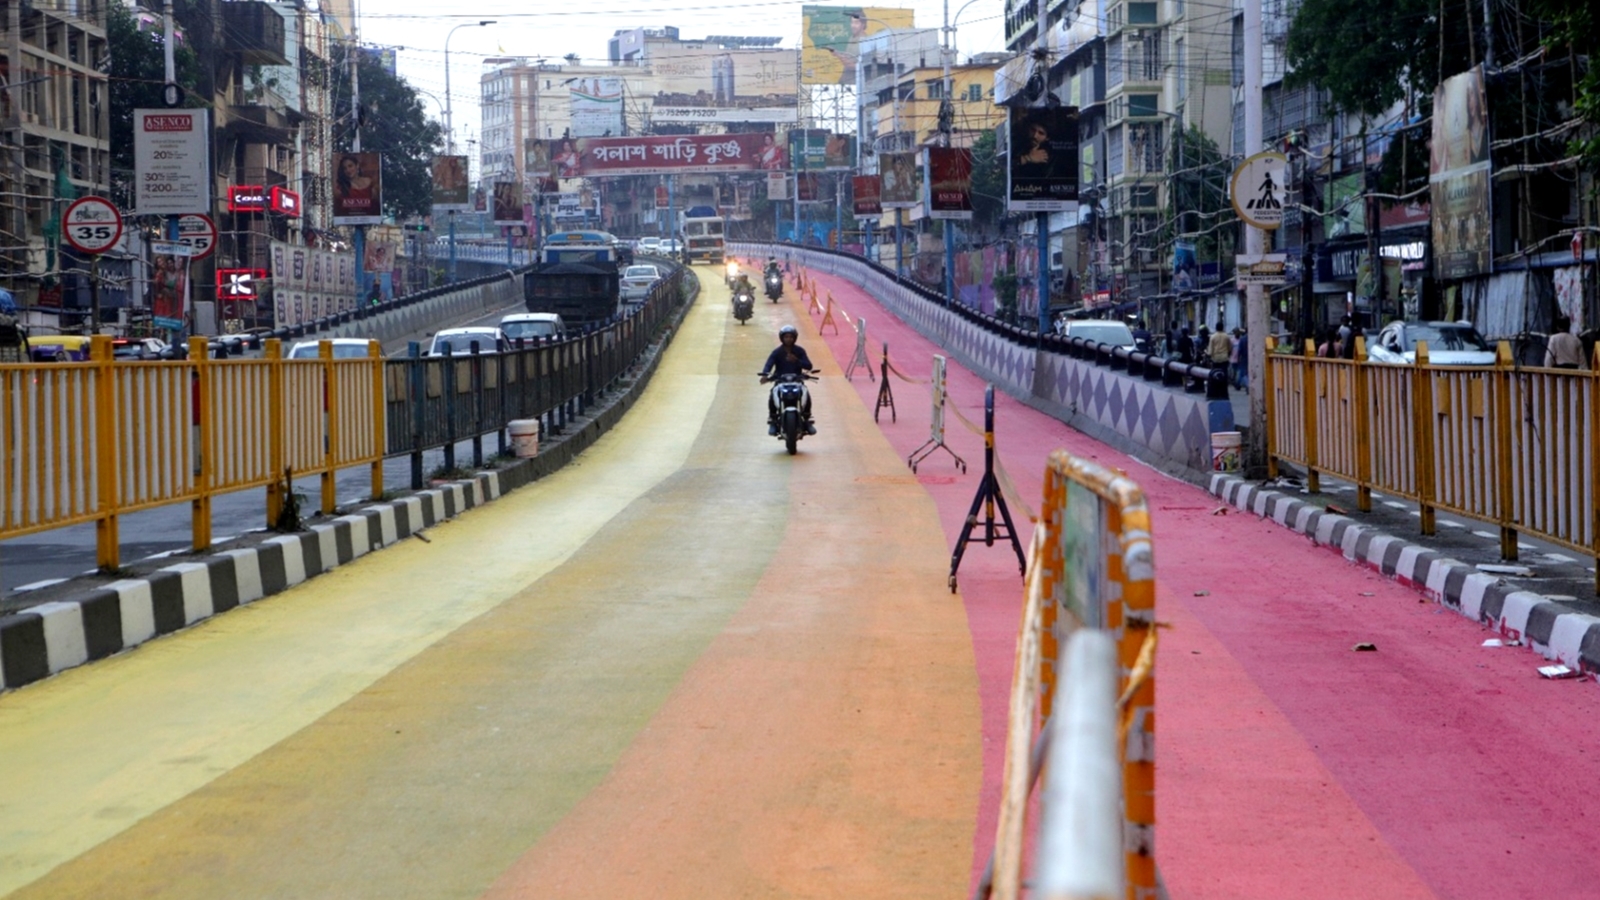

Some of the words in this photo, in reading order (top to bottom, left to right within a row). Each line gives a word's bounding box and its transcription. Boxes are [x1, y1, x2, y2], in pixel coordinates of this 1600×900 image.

[665, 109, 691, 117] 75200
[692, 109, 717, 117] 75200
[152, 116, 191, 127] SENCO
[592, 144, 647, 162] পলাশ
[652, 138, 697, 163] শাড়ি
[701, 140, 742, 163] কুঞ্জ
[77, 226, 111, 240] 35
